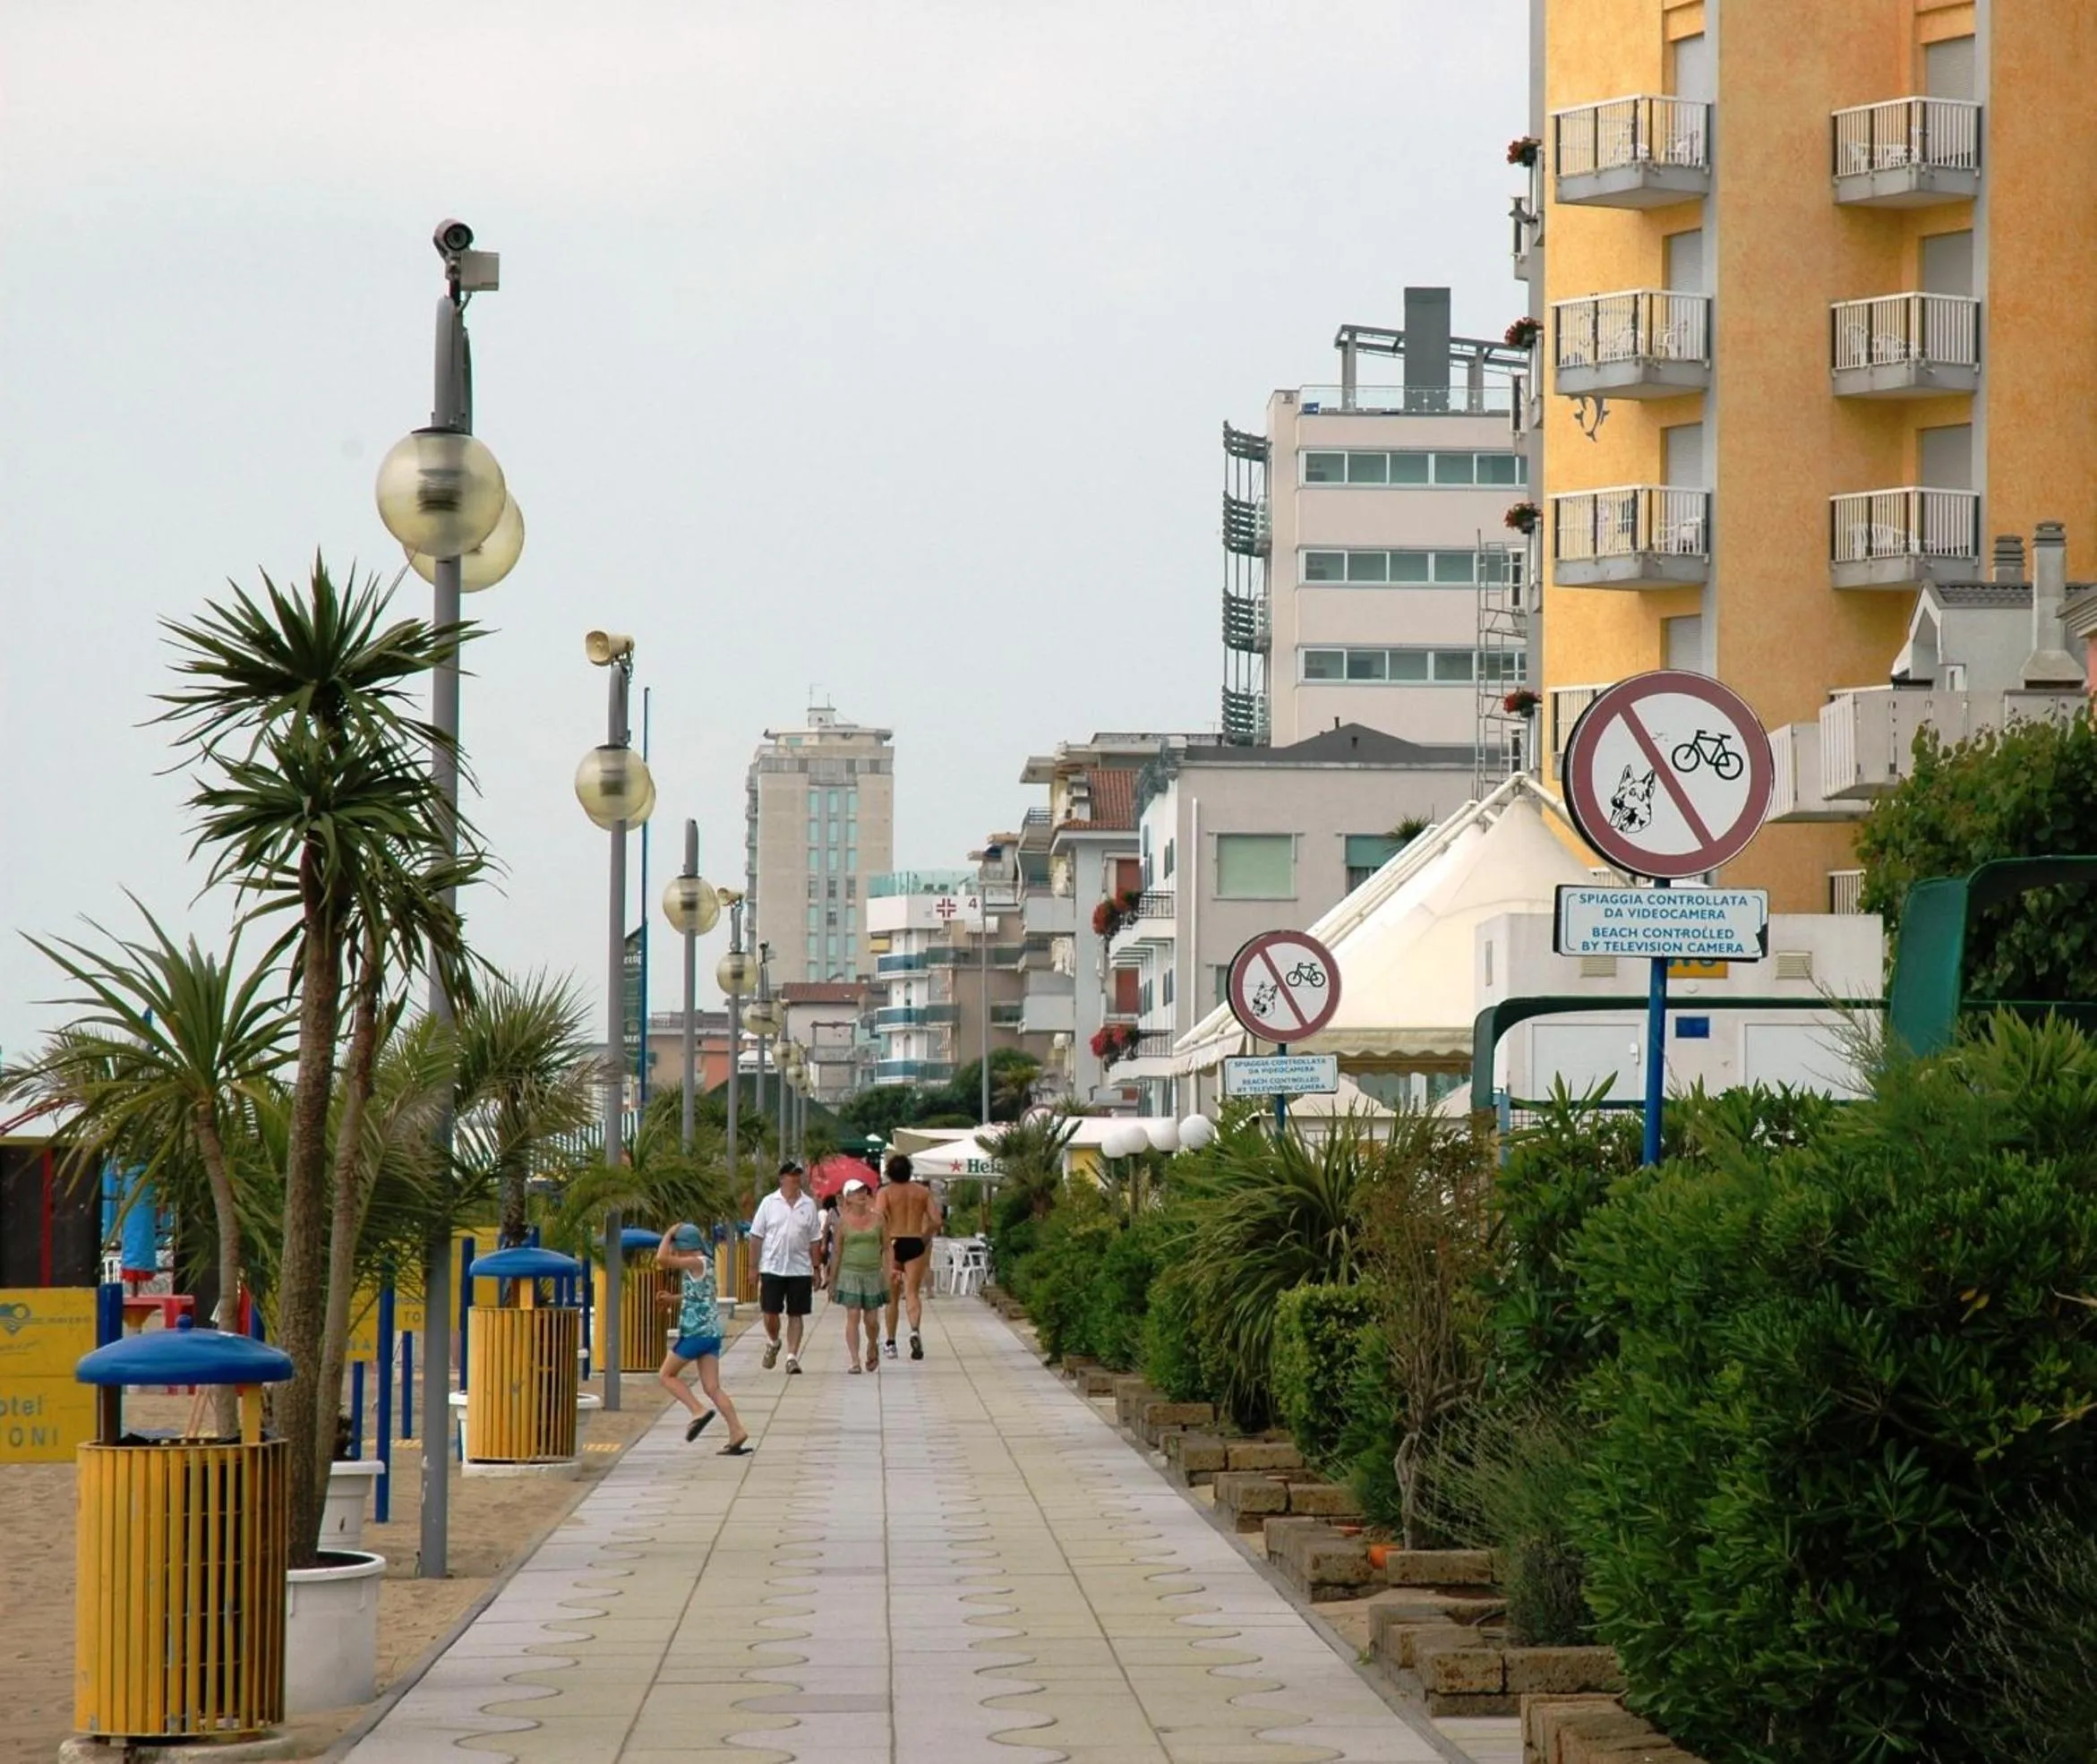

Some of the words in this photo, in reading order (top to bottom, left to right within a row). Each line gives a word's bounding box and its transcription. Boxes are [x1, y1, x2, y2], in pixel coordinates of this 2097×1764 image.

[968, 897, 977, 909] 4
[1579, 893, 1642, 906] SPIAGGIA
[1647, 895, 1748, 907] CONTROLLATA
[1604, 907, 1624, 919] DA
[1629, 908, 1726, 921] VIDEOCAMERA
[1592, 927, 1638, 938] BEACH
[1642, 928, 1734, 940] CONTROLLED
[1581, 940, 1598, 952] BY
[1603, 941, 1683, 954] TELEVISION
[1687, 942, 1744, 954] CAMERA
